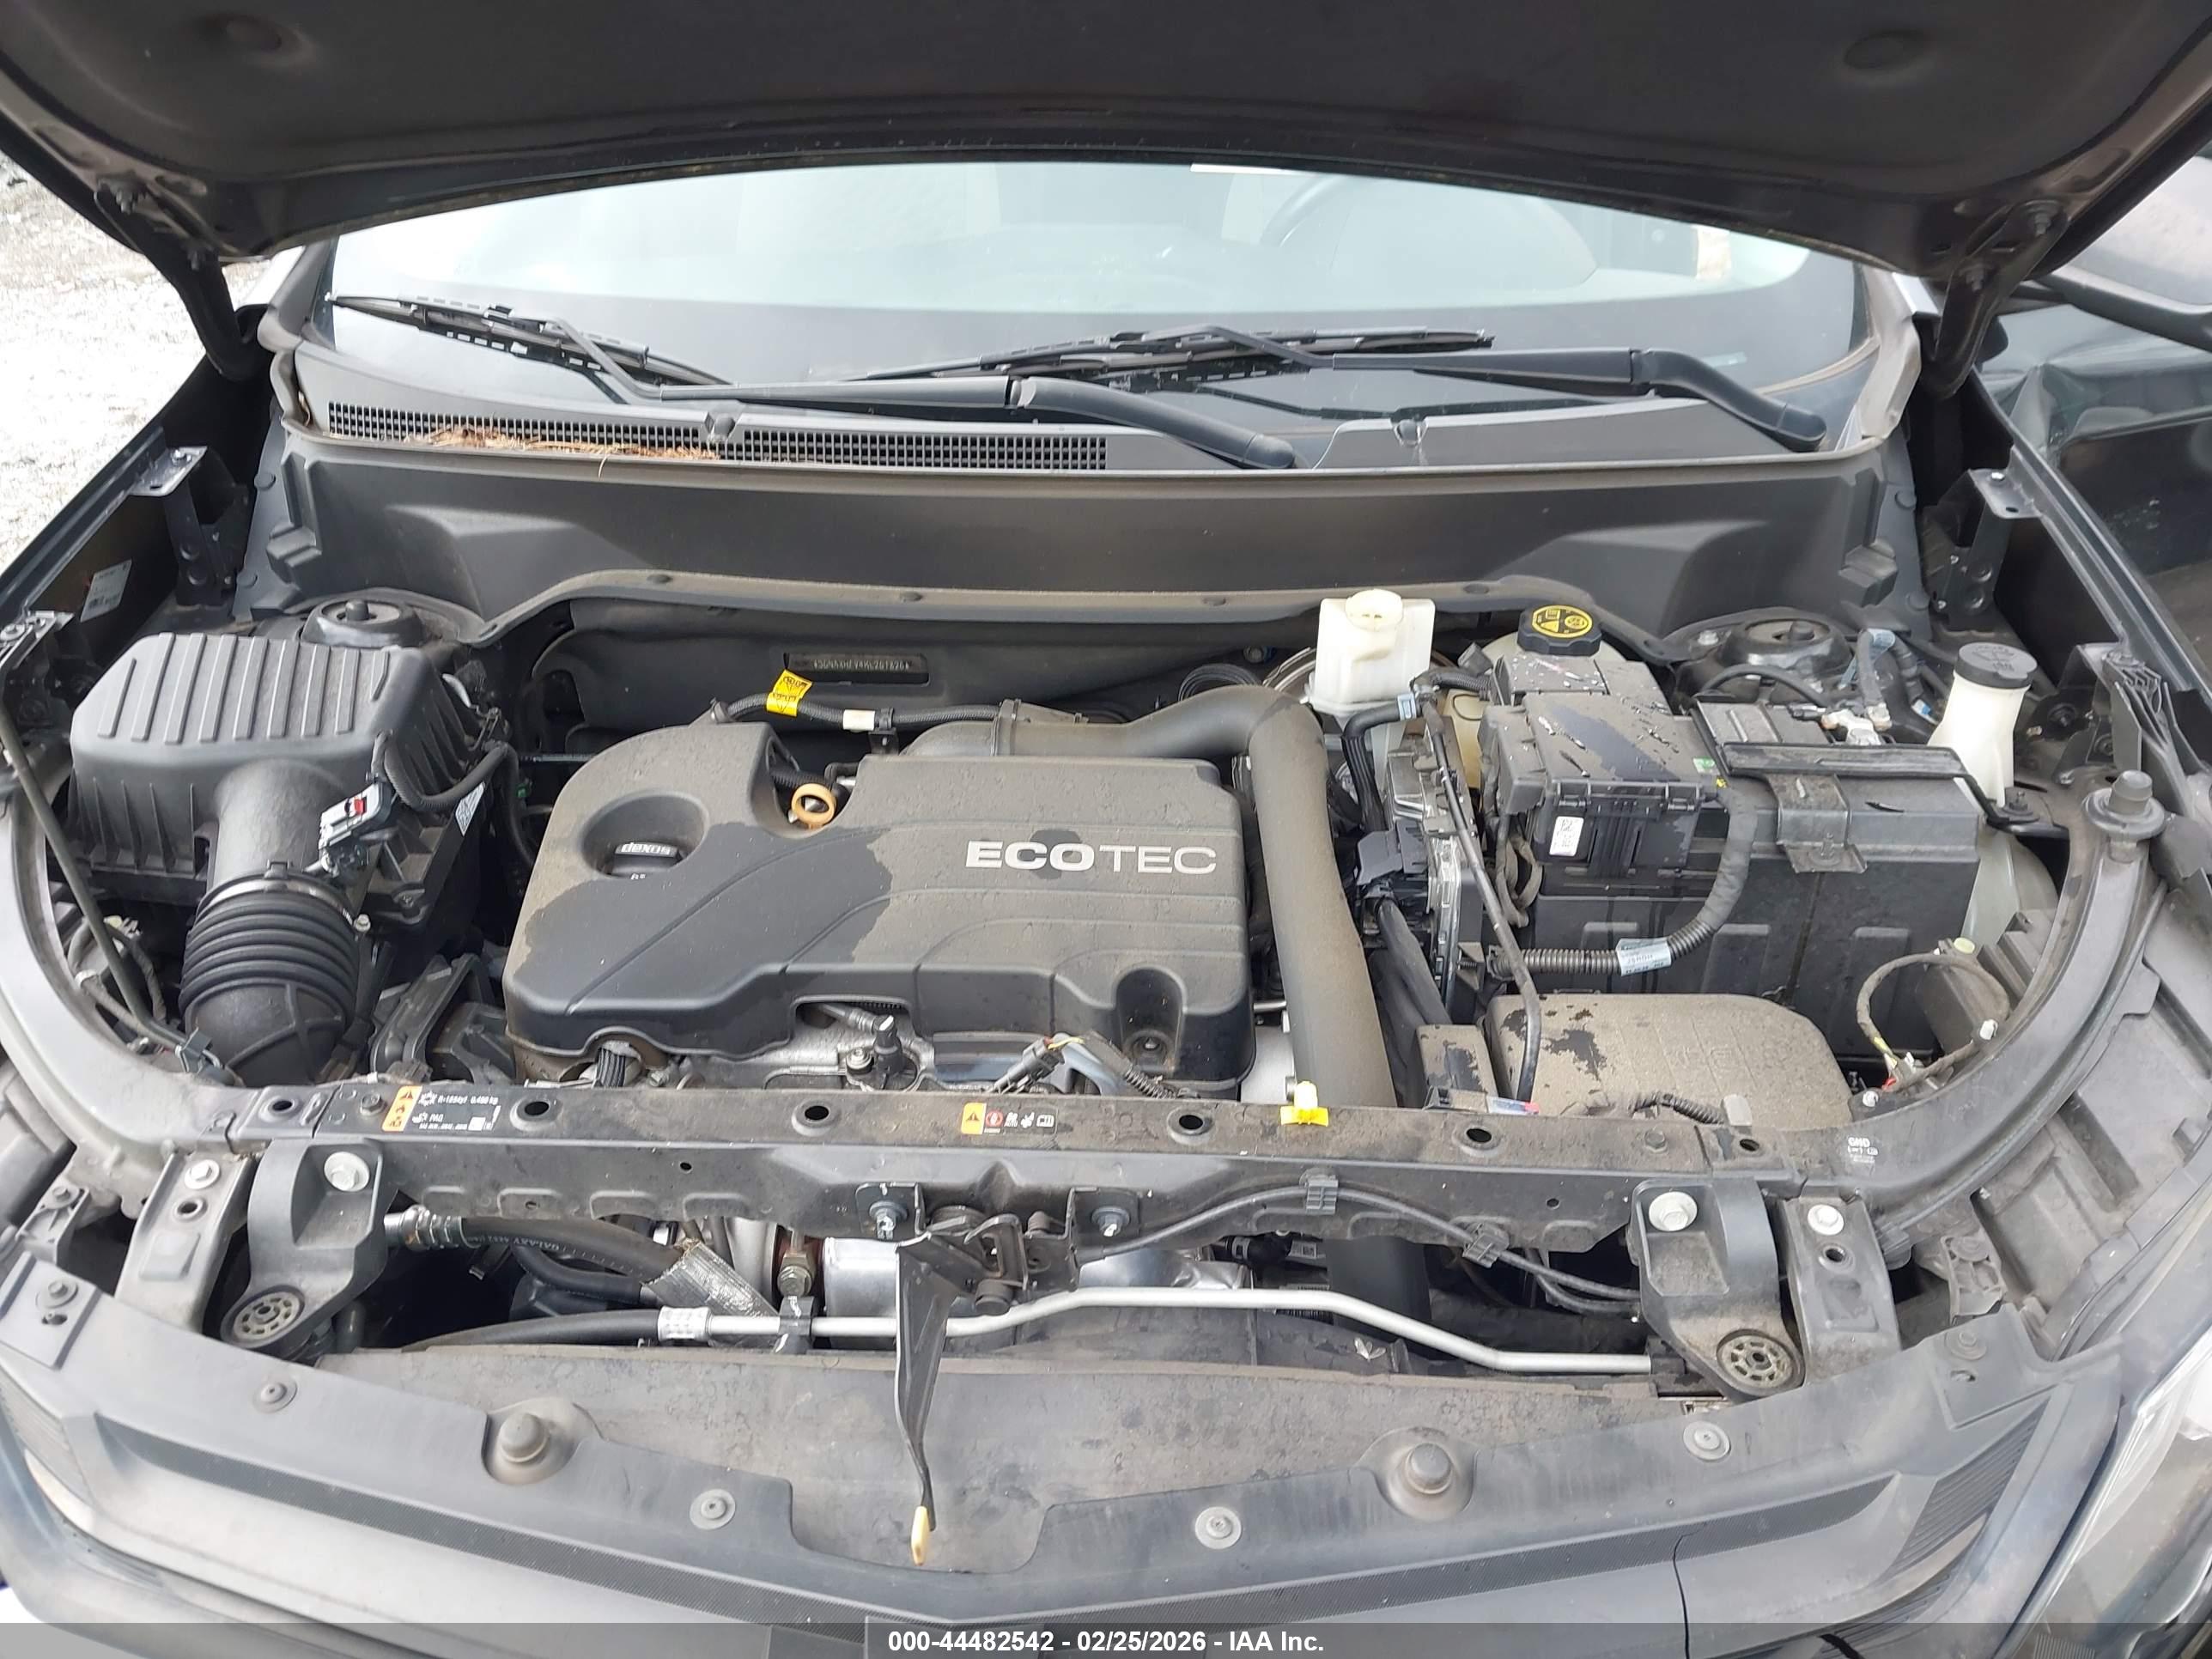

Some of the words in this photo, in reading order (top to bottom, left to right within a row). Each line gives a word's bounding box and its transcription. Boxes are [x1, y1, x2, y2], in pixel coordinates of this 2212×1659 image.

[621, 842, 671, 855] dexos
[965, 840, 1217, 874] ECOTEC
[1848, 1137, 1870, 1148] GND
[513, 1237, 560, 1250] GALAXY
